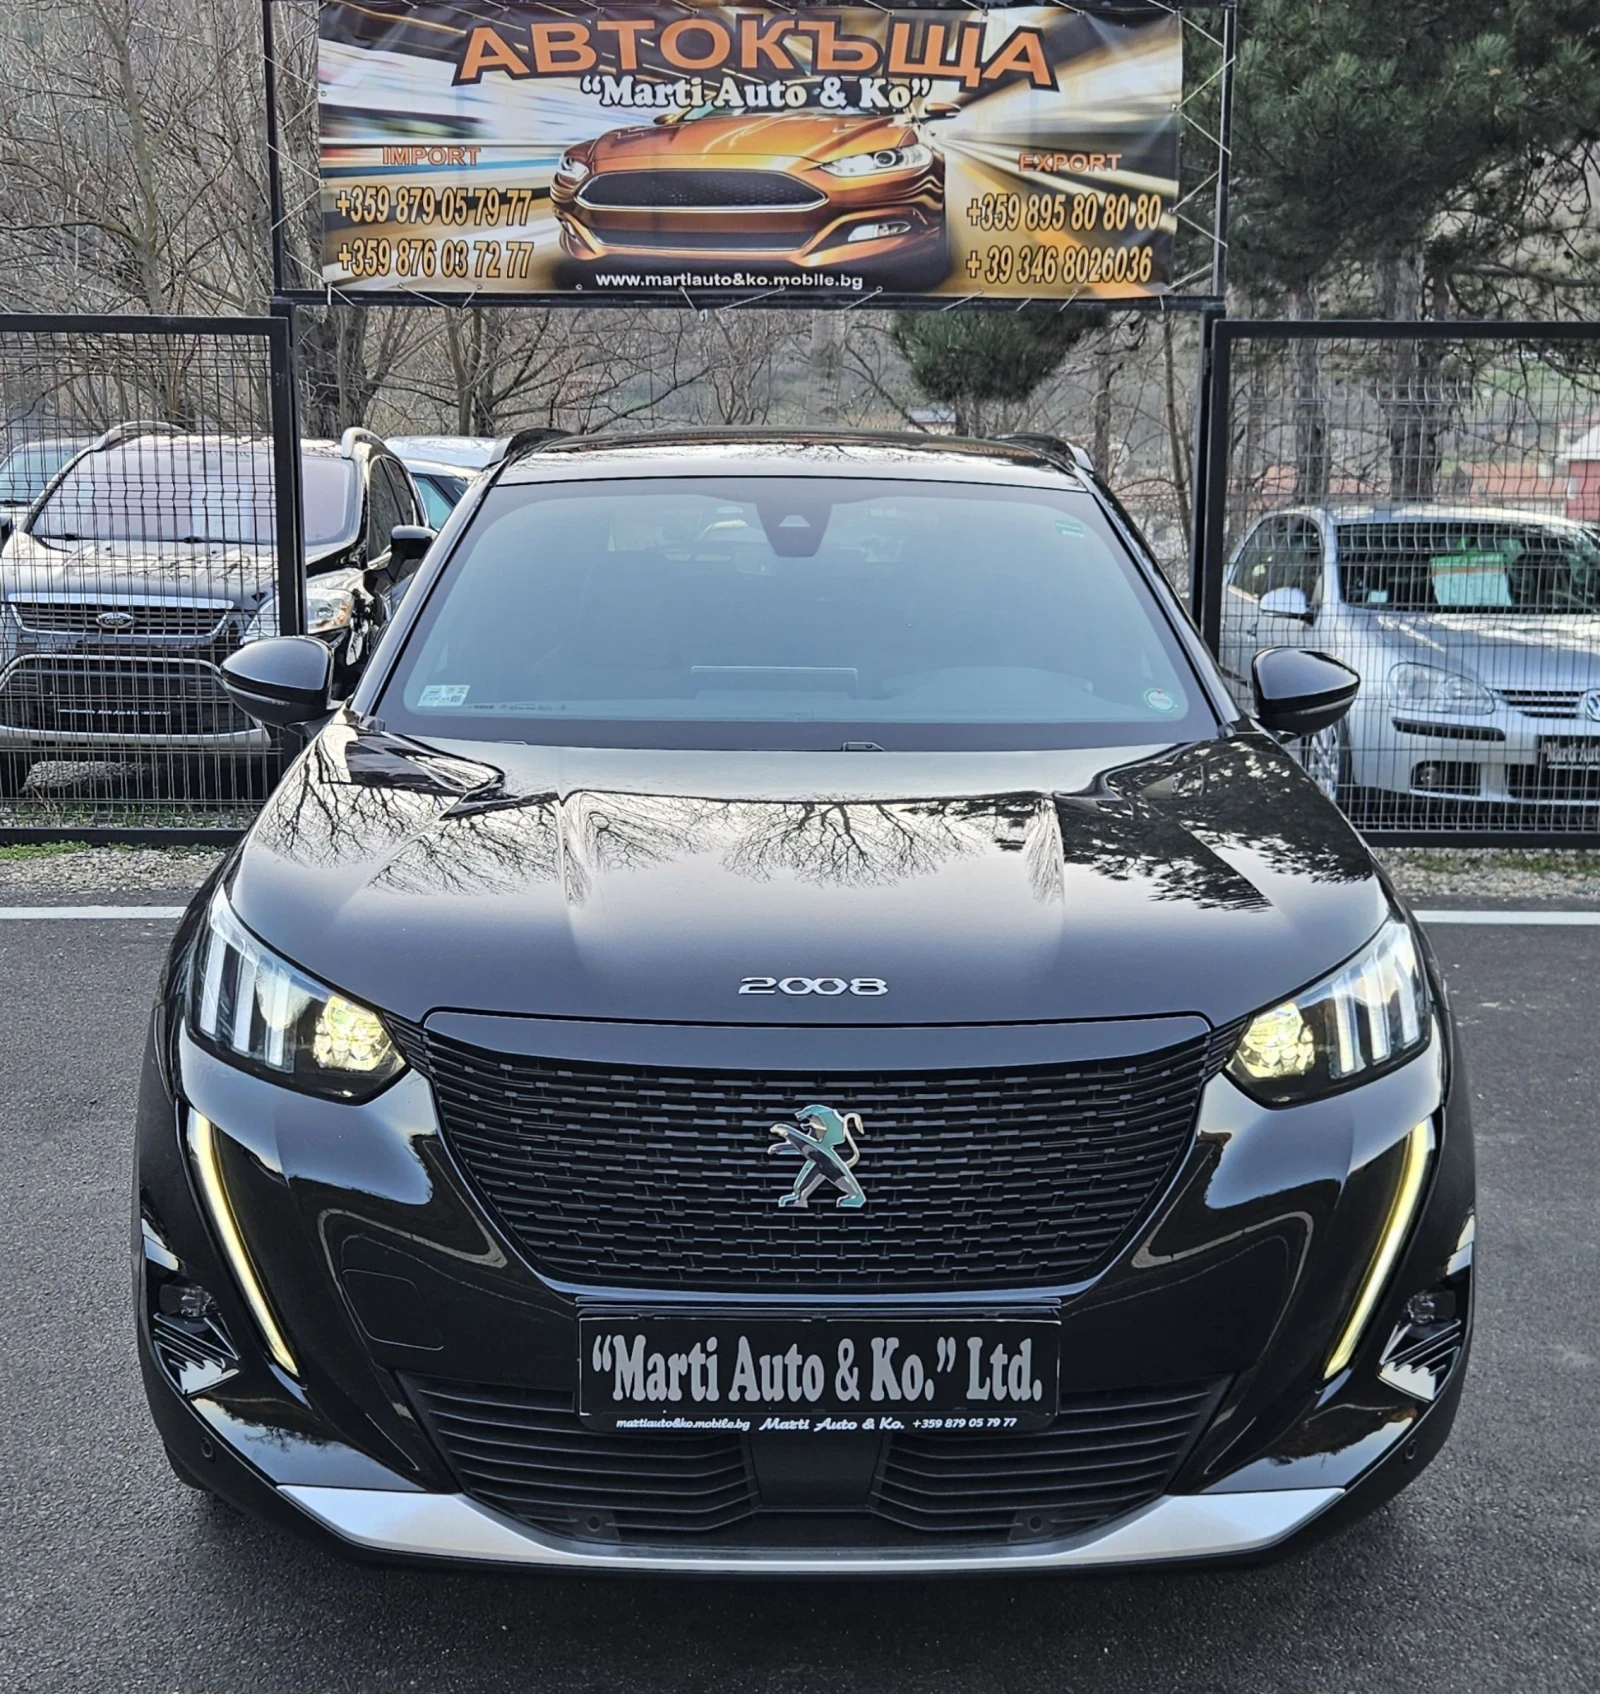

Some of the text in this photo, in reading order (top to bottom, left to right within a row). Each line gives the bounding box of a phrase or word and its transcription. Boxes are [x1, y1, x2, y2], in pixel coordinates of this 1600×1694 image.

[454, 15, 1058, 91] АВТОКЪЩА
[716, 76, 808, 108] Auto
[819, 77, 848, 109] &
[382, 146, 481, 166] IMPORT
[1018, 152, 1122, 172] EXPORT
[336, 185, 532, 226] +359 879 05 79 77
[967, 192, 1161, 231] +359 895 80 80 80
[338, 238, 534, 278] +359 876 03 72 77
[985, 245, 1013, 284] 39
[1017, 245, 1059, 284] 346
[1063, 246, 1153, 284] 8026036
[595, 272, 863, 290] www.martiauto&ko.mobile.bg
[738, 976, 889, 996] 2008
[592, 1333, 1043, 1401] “Marti Auto & Ko.” Ltd.
[758, 1417, 810, 1431] Marti
[813, 1417, 857, 1432] Auto
[861, 1417, 875, 1430] &
[879, 1416, 905, 1430] Ko.
[912, 1418, 942, 1429] +359
[944, 1418, 966, 1429] 879
[968, 1418, 983, 1428] 05
[986, 1418, 1001, 1428] 79
[1003, 1417, 1018, 1428] 77
